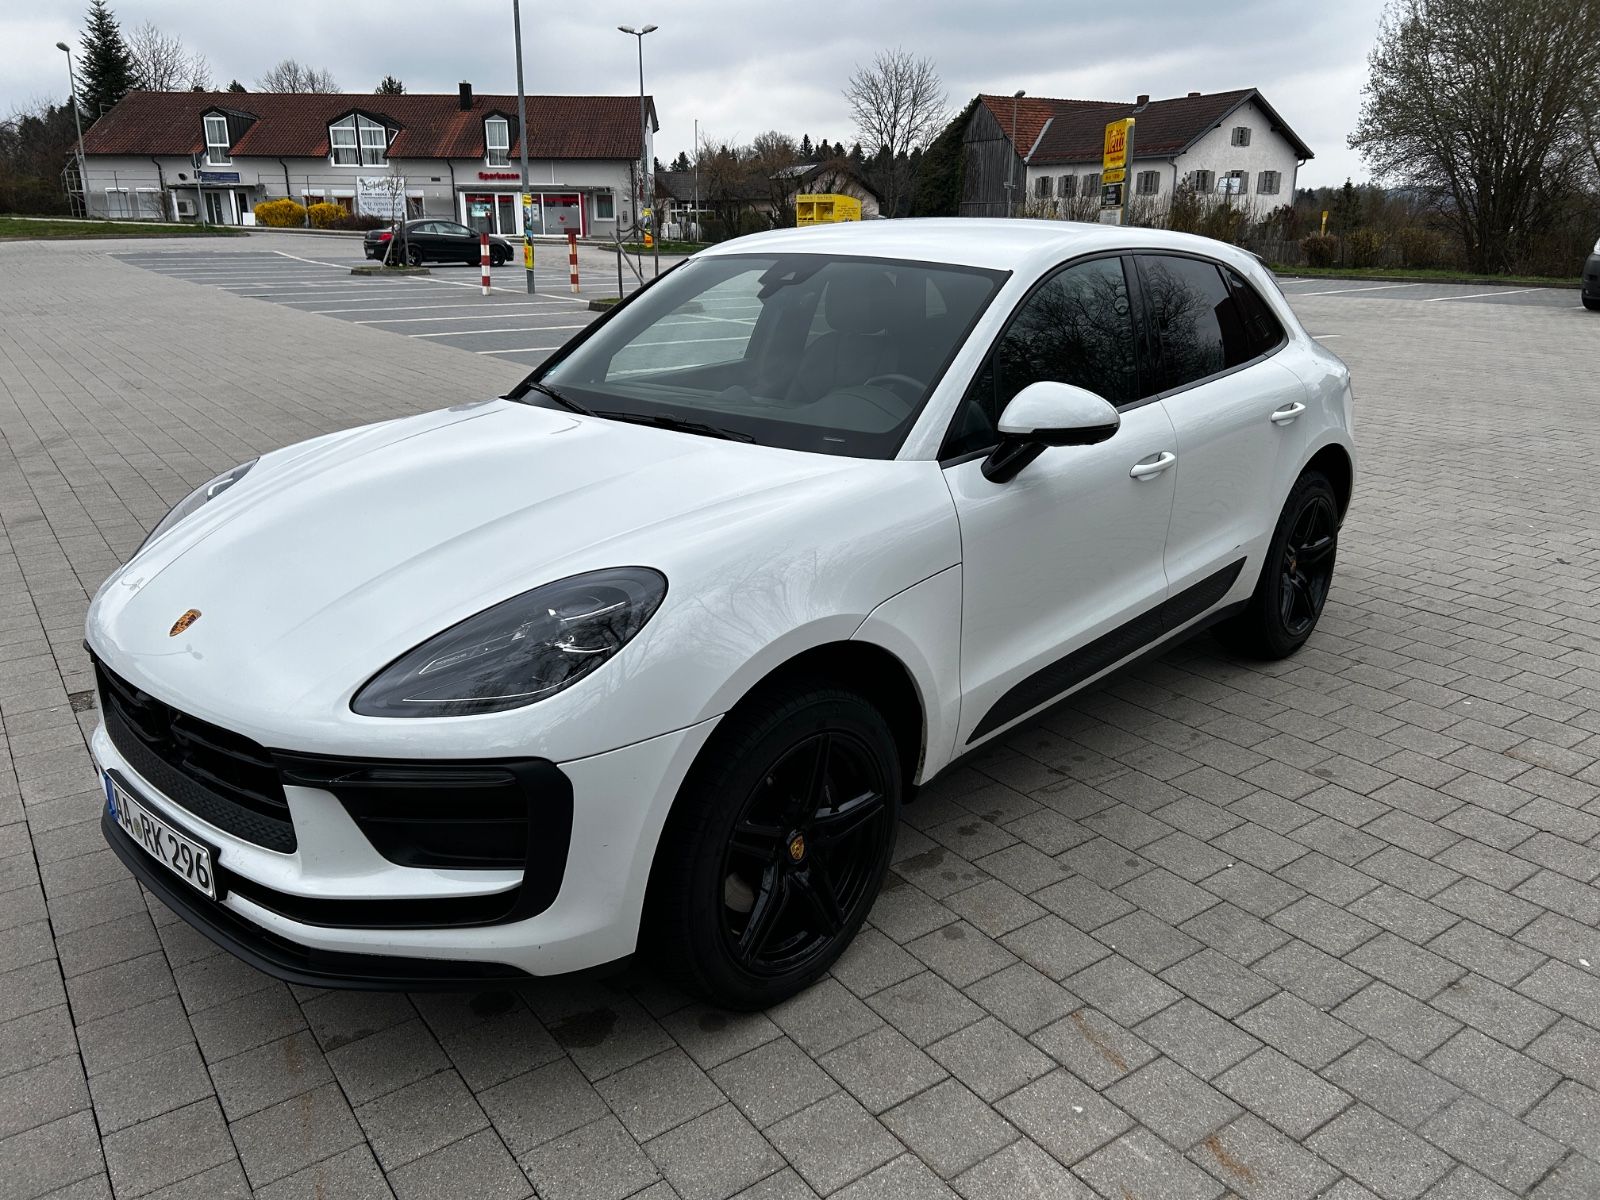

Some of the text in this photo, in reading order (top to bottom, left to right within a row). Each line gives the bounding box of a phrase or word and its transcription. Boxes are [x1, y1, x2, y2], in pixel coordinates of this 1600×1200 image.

[478, 172, 520, 180] Sparkasse
[140, 811, 168, 863] RK
[168, 833, 210, 889] 296
